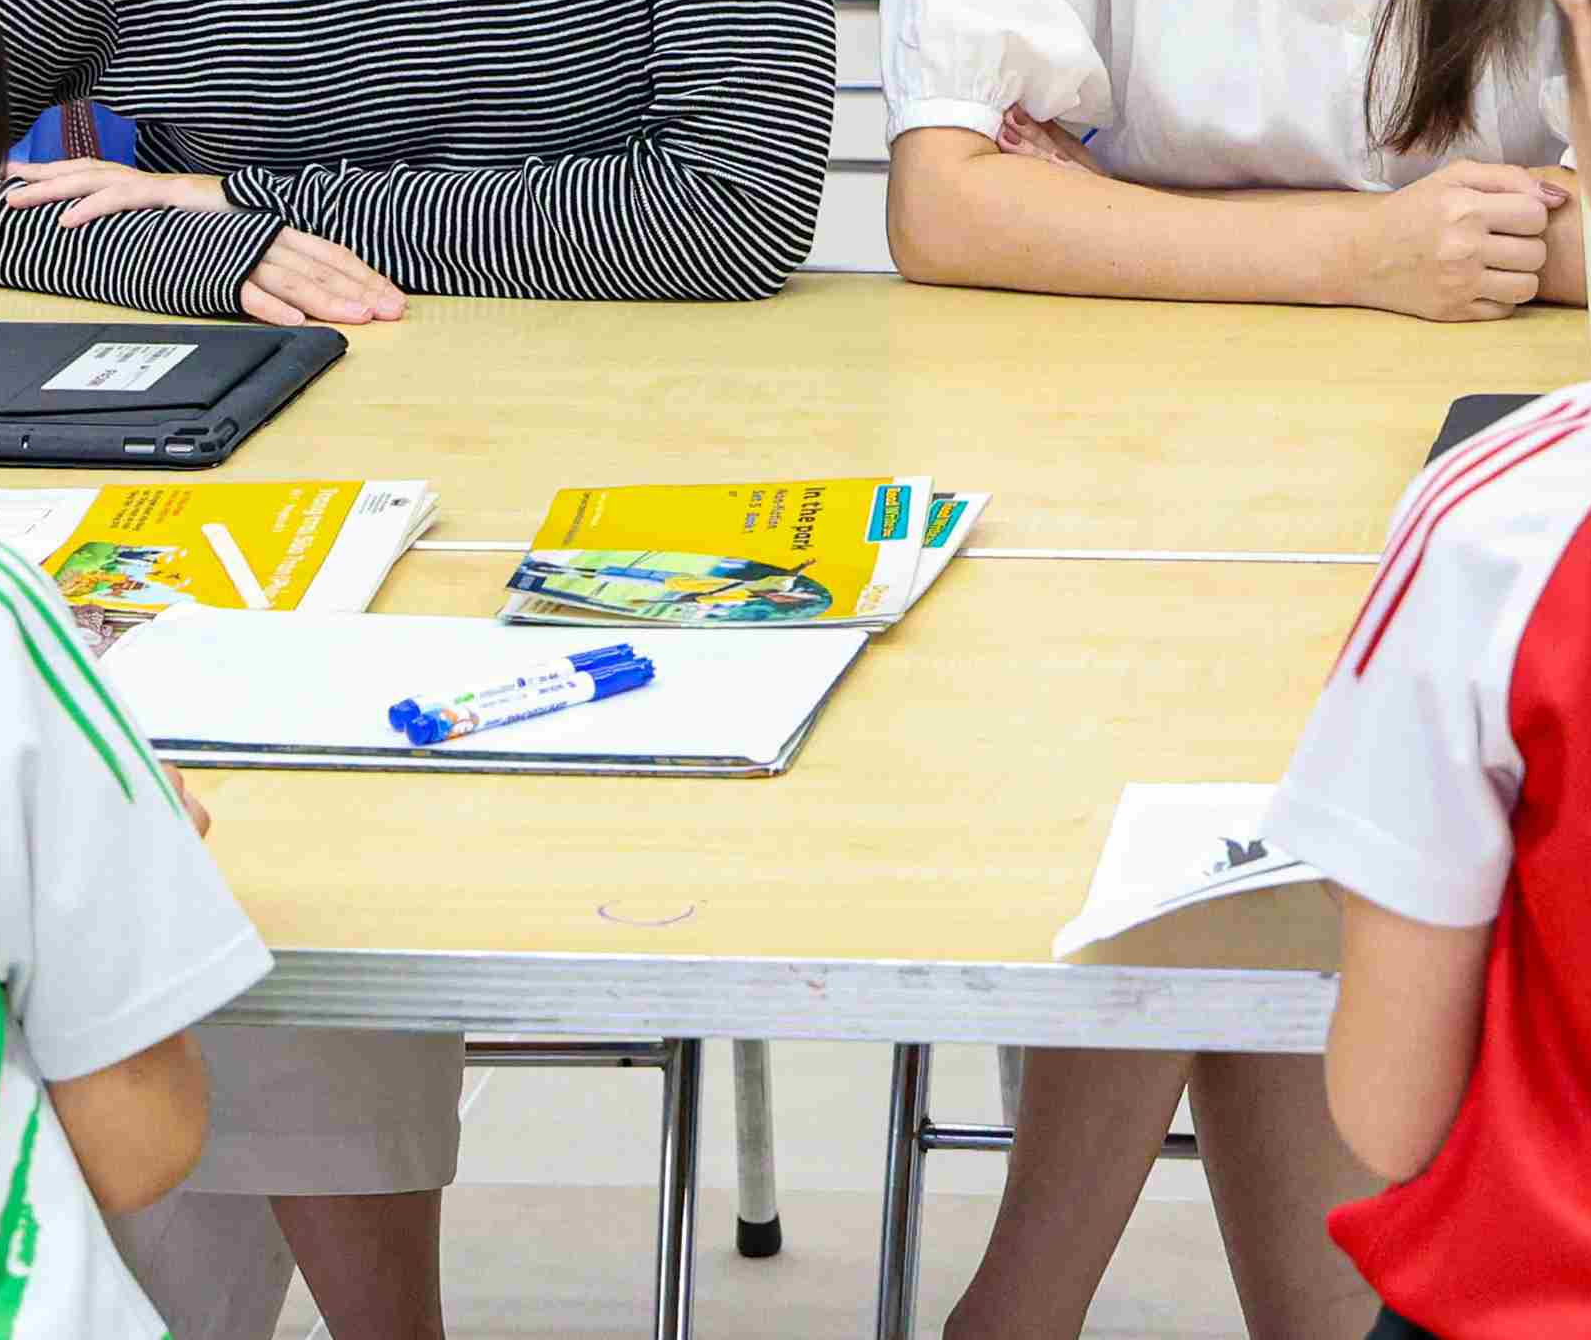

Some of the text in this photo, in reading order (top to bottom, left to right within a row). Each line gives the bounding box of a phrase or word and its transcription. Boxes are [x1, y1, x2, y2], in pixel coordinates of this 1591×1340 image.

[791, 486, 826, 550] In the park
